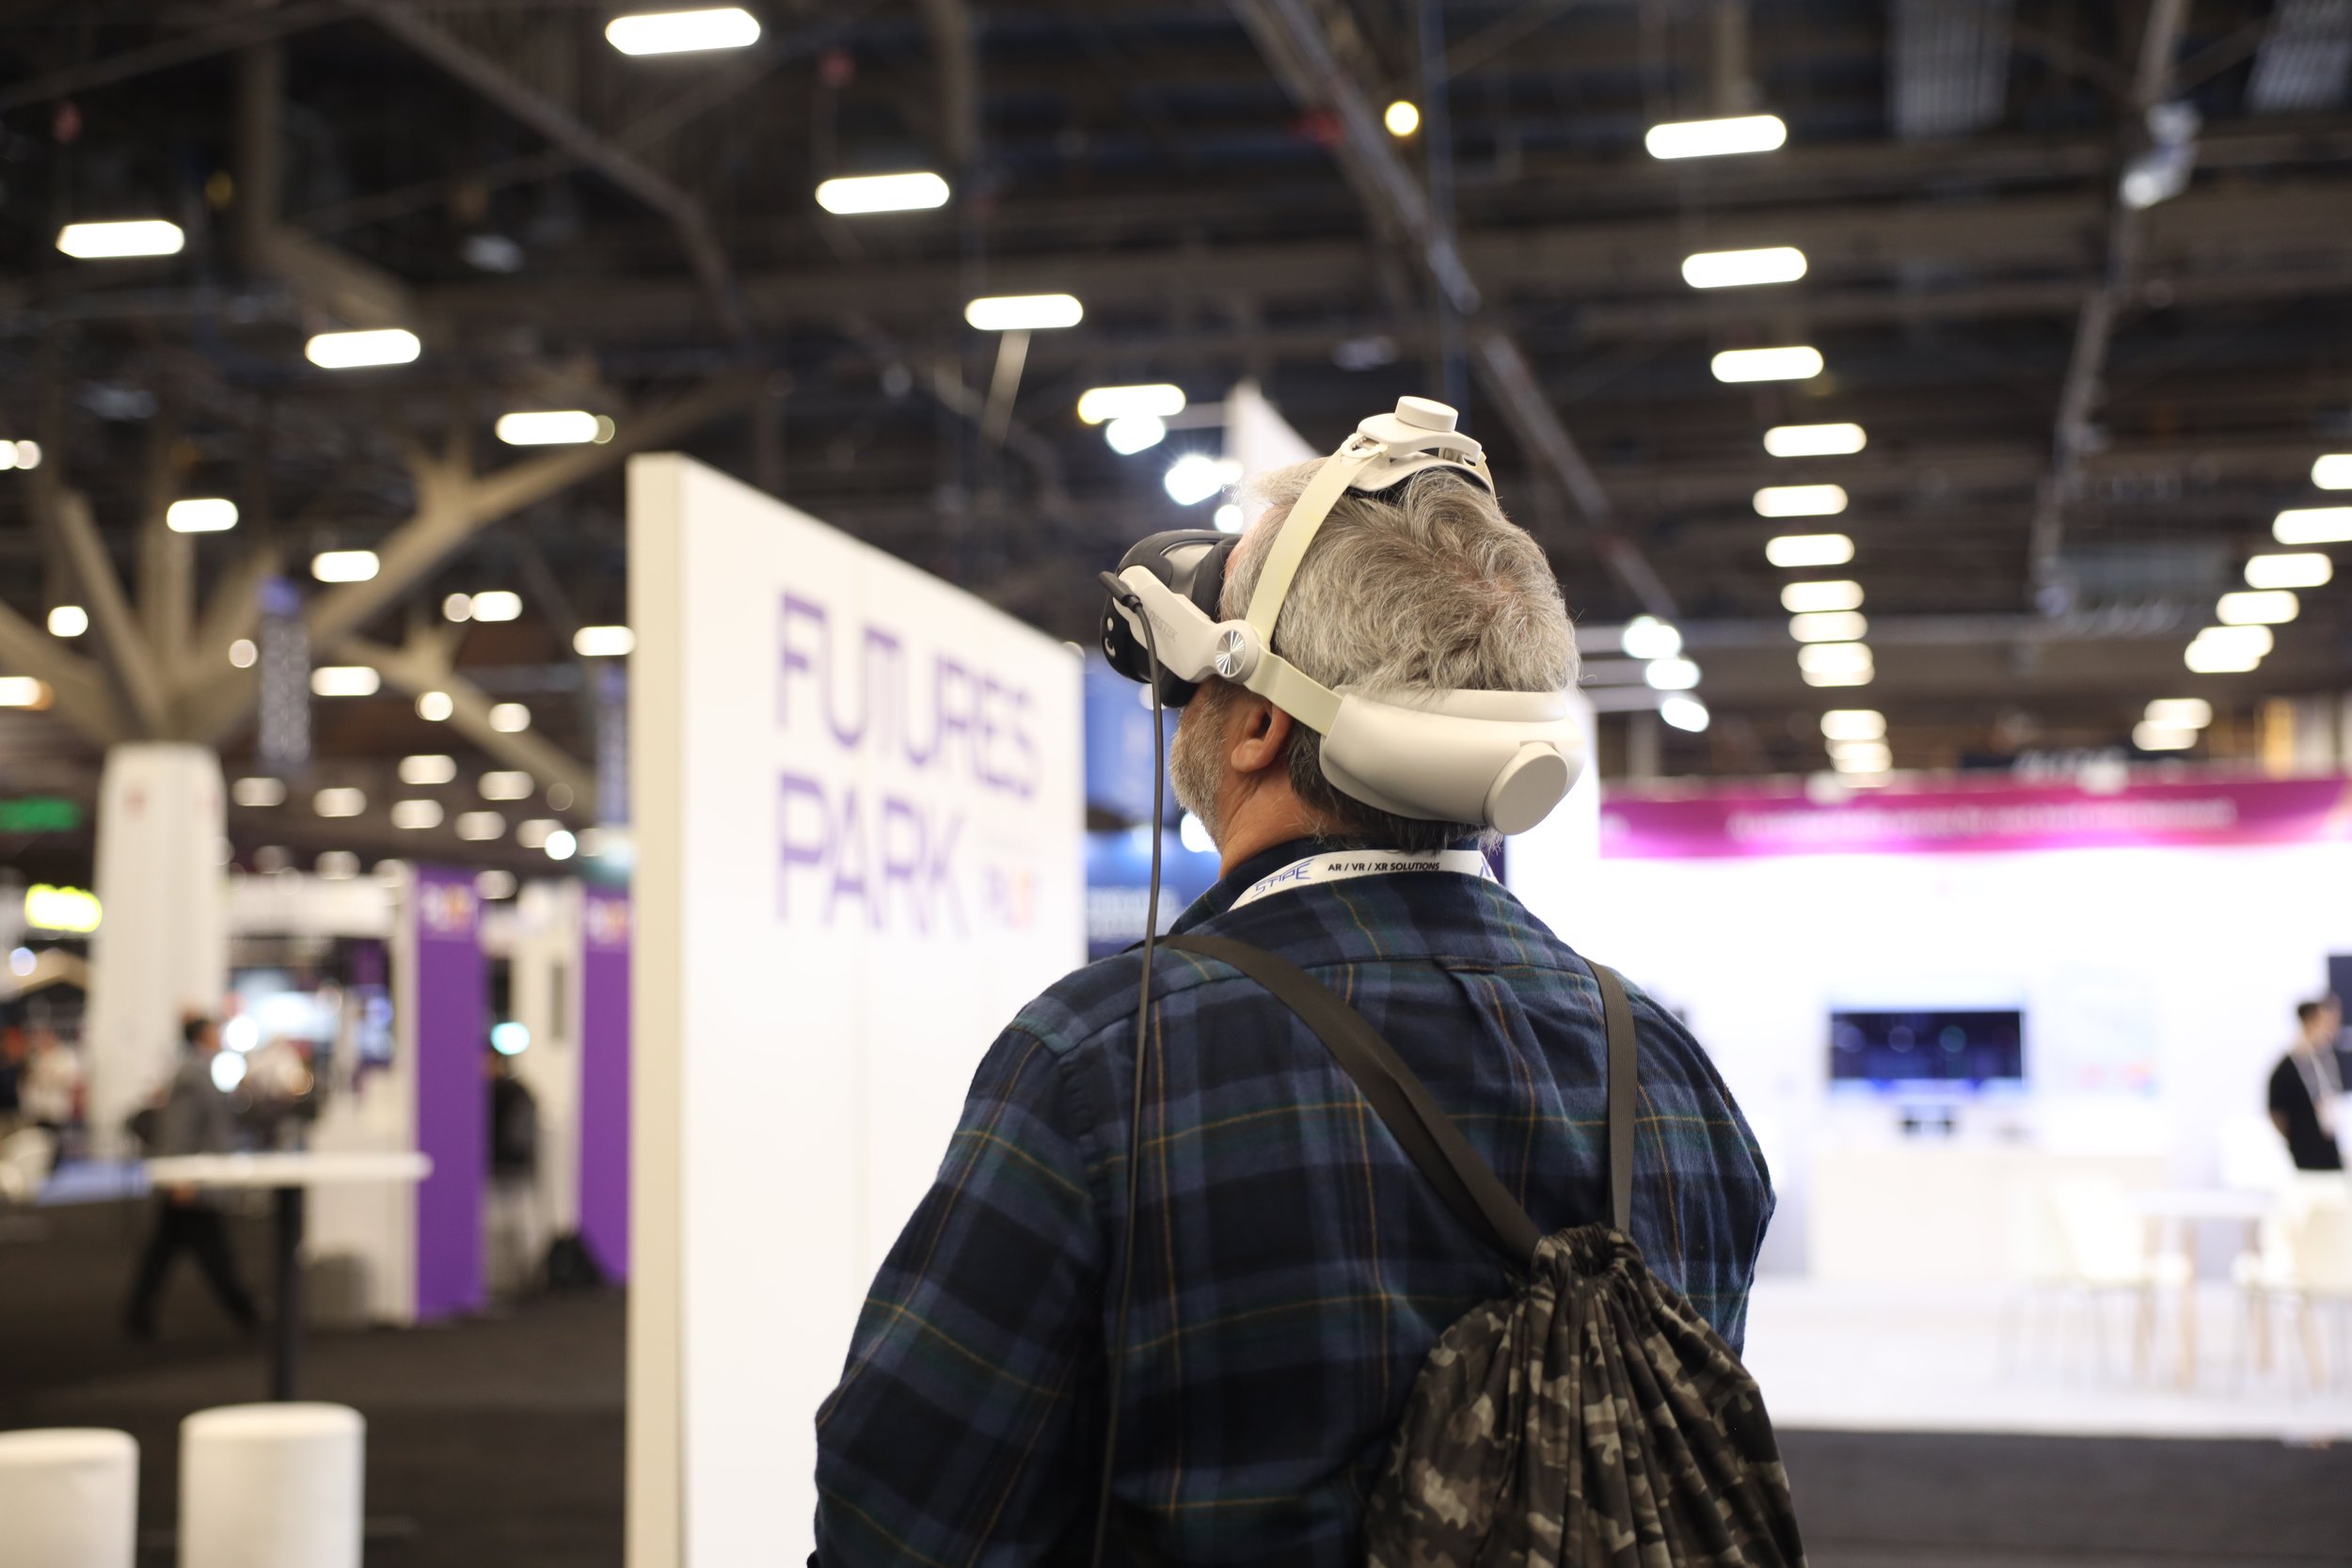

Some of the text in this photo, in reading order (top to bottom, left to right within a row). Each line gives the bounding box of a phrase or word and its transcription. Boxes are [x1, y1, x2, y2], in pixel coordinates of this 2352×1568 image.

[777, 589, 1041, 801] FUTURES
[777, 768, 971, 941] PARK
[1251, 858, 1314, 898] STIPE
[1327, 863, 1342, 871] AR
[1351, 863, 1365, 871] VR
[1374, 863, 1388, 871] XR
[1390, 862, 1440, 871] SOLUTIONS
